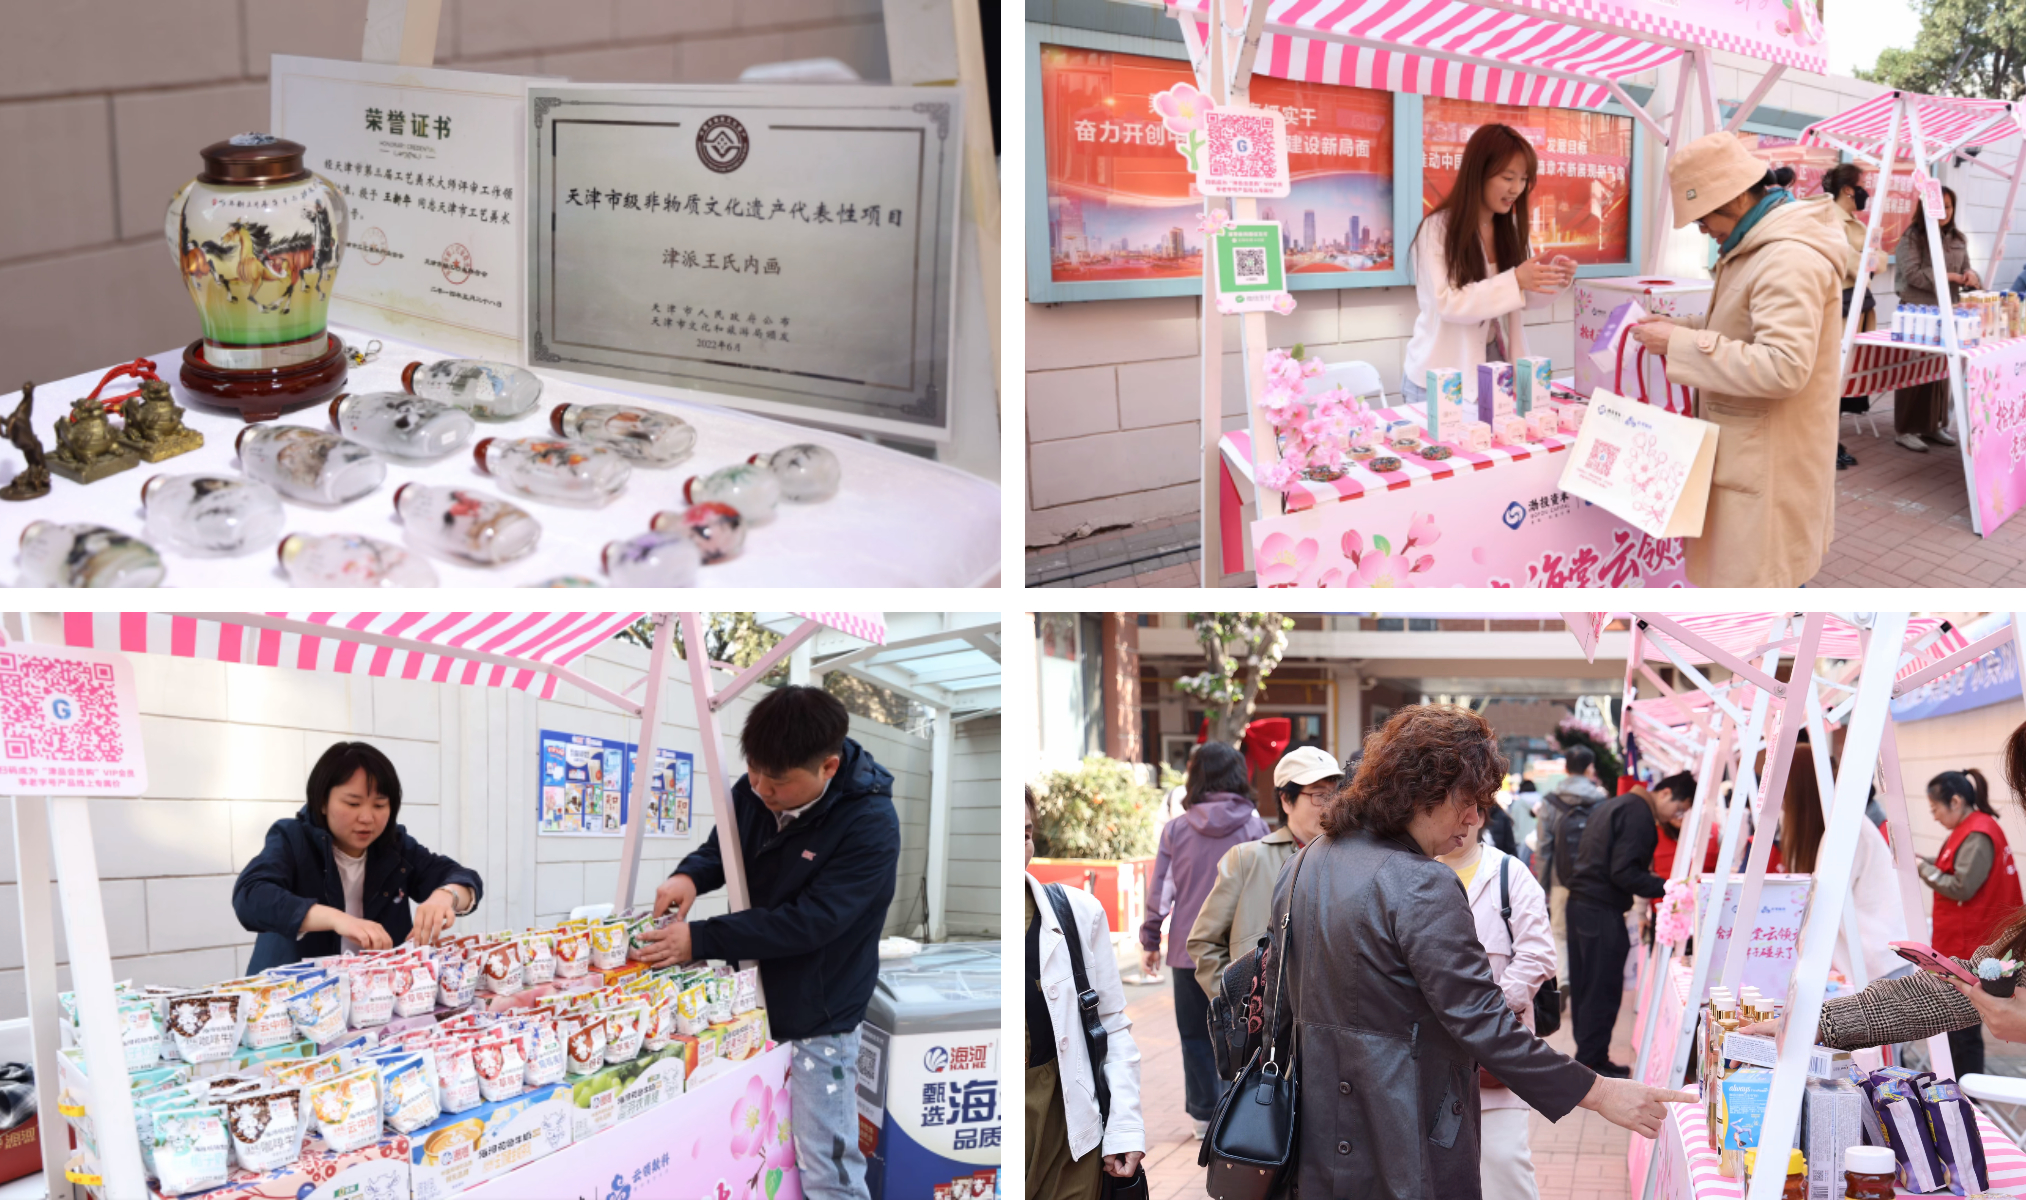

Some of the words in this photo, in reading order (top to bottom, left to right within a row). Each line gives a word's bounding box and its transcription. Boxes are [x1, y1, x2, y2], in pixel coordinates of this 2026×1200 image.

[364, 107, 452, 140] 荣誉证书
[1236, 139, 1249, 153] G
[1286, 134, 1371, 158] 建设新局面
[1546, 138, 1588, 156] 发展目标
[564, 187, 904, 227] 天津市级非物质文化遗产代表性项目
[661, 247, 782, 276] 津派王氏内画
[651, 302, 791, 328] 天津市人民政府公布
[650, 316, 791, 342] 天津市文化和旅游局颁发
[696, 338, 742, 353] 2022年6月
[1528, 491, 1570, 512] 渤投资本
[52, 698, 72, 720] G
[949, 1062, 970, 1071] HAI
[972, 1061, 988, 1070] HE
[950, 1045, 988, 1063] 海河
[1729, 1084, 1751, 1094] always
[920, 1082, 947, 1128] 甄选
[946, 1079, 1001, 1126] 海
[953, 1127, 1002, 1151] 品质
